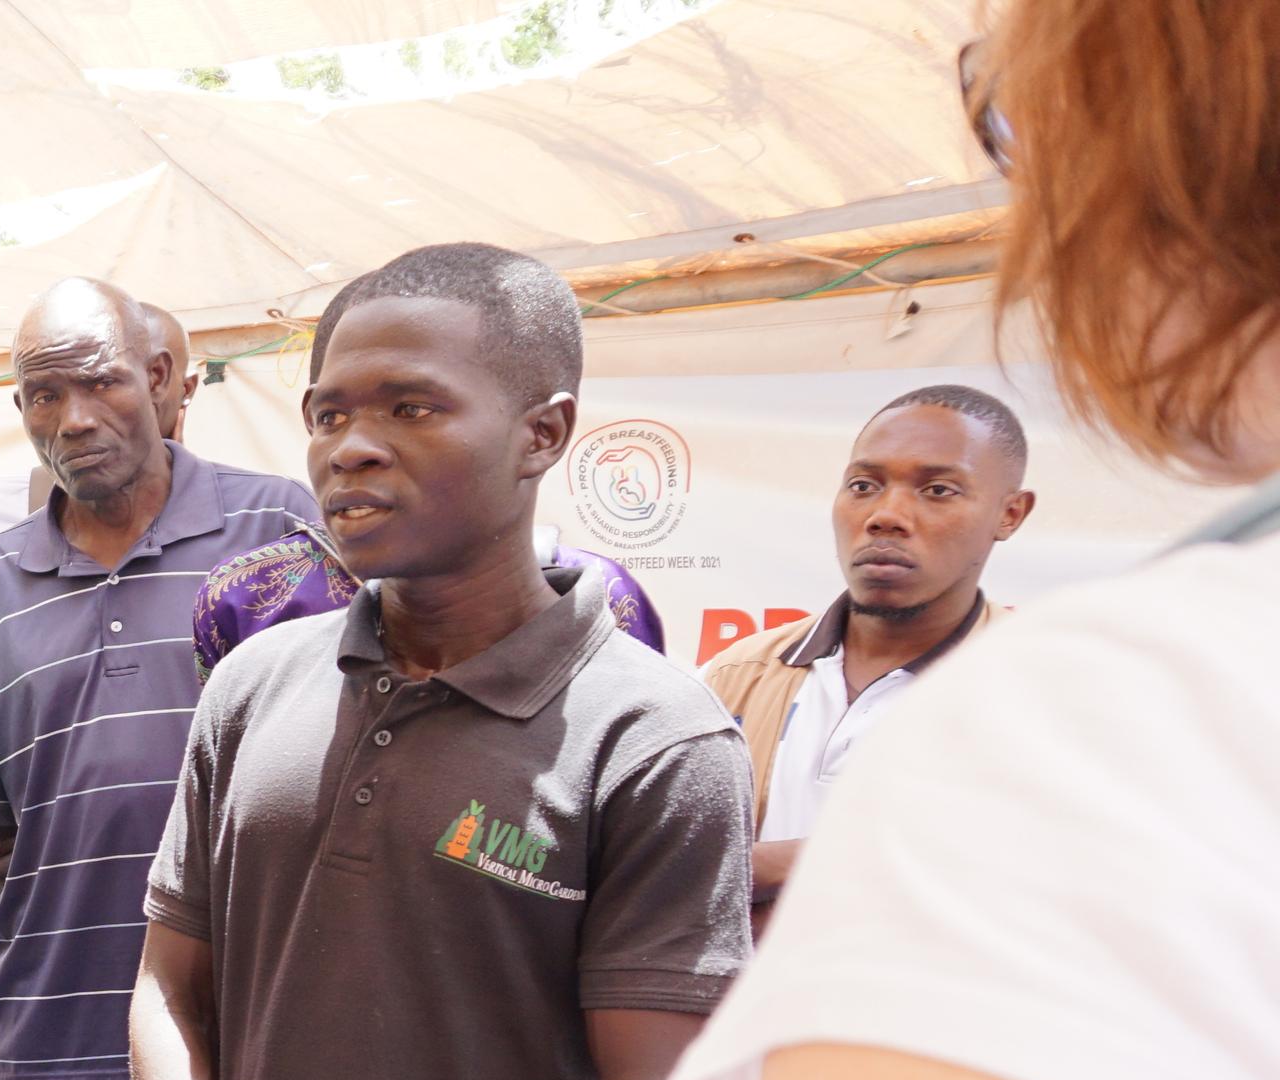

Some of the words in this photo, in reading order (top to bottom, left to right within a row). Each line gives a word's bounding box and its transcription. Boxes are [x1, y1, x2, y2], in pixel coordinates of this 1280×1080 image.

[578, 436, 606, 490] PROTECT
[608, 429, 677, 488] BREASTFEEDING
[590, 509, 621, 536] SHARED
[622, 502, 674, 539] RESPONSIBILITY
[667, 555, 696, 569] WEEK
[700, 555, 722, 569] 2021
[486, 818, 549, 874] VMG
